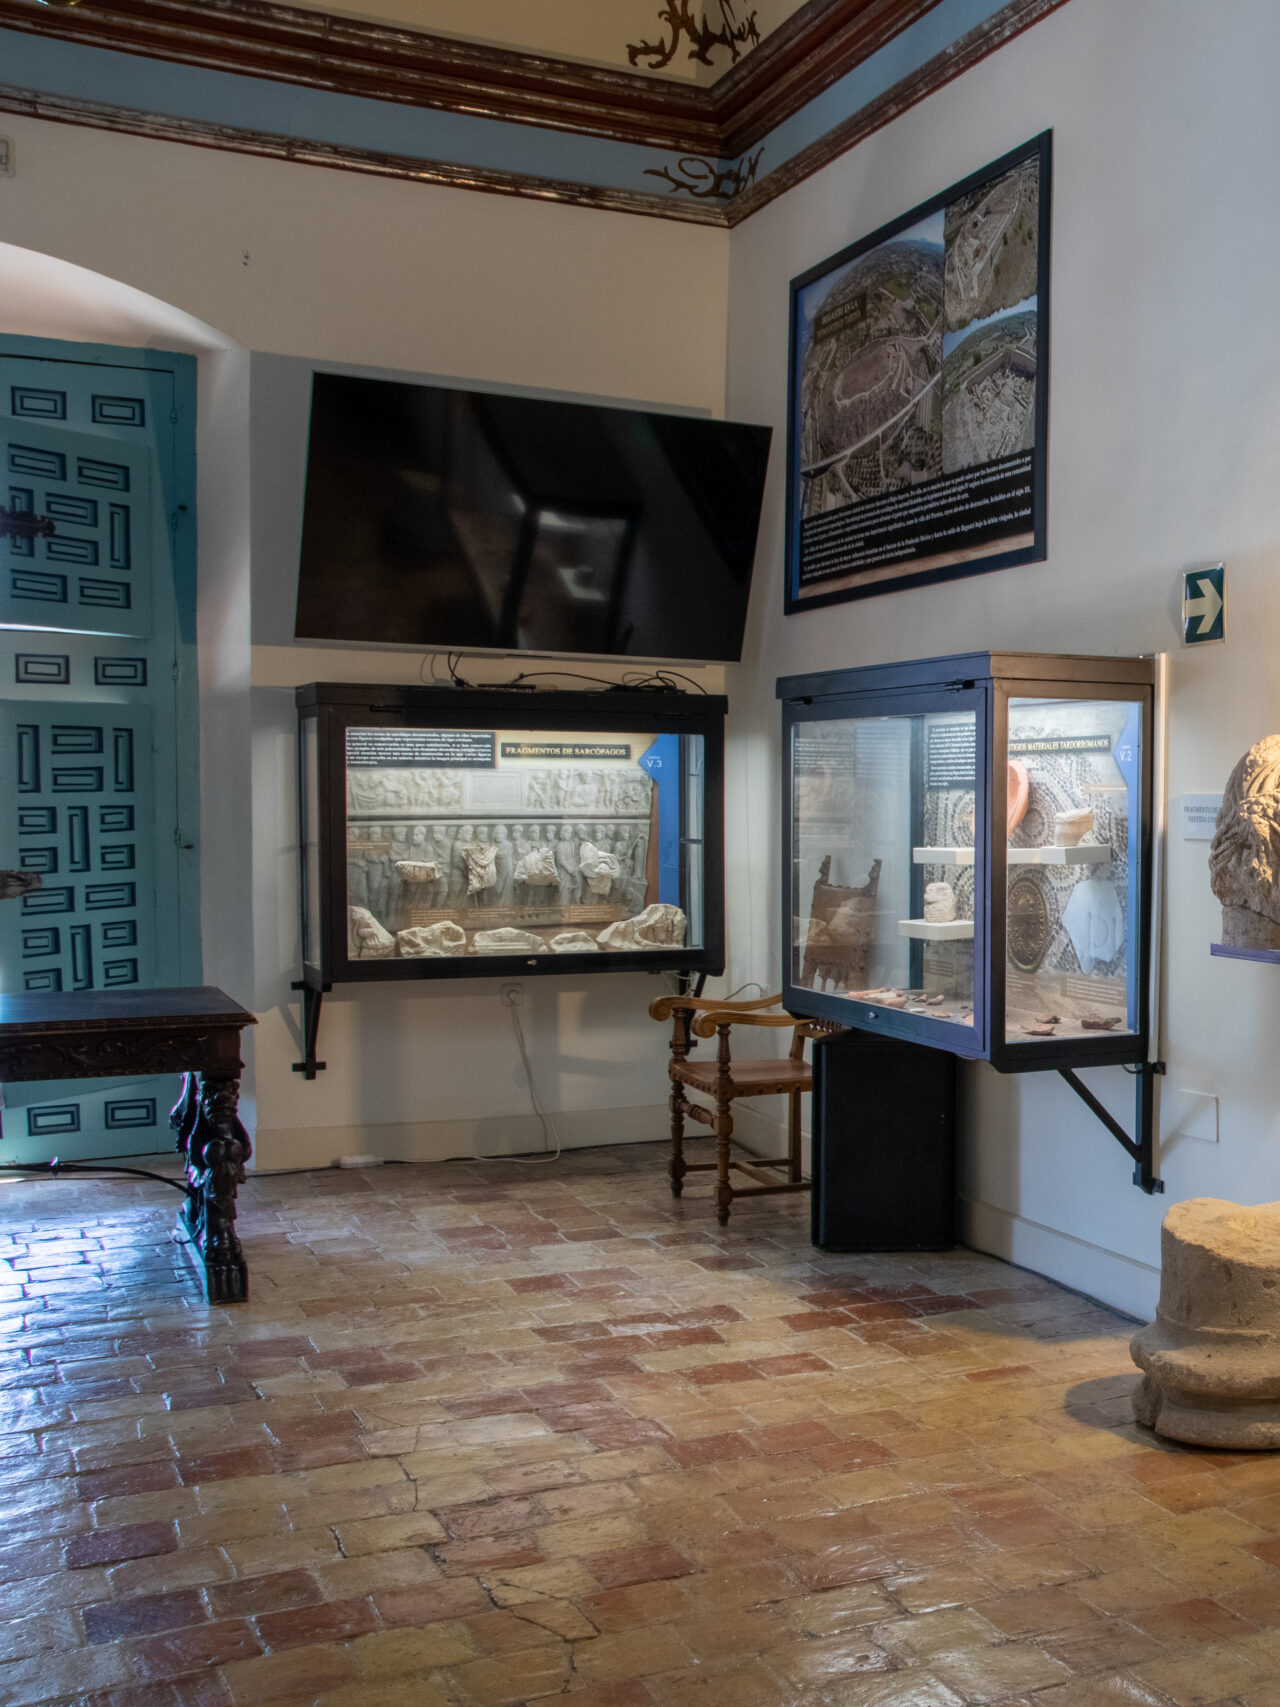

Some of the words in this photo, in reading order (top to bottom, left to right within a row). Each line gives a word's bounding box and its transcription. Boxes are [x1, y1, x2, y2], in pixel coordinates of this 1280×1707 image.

[505, 746, 561, 755] FRAGMENTOS
[562, 747, 574, 755] DE
[574, 746, 626, 756] SARCÓFAGOS
[1120, 750, 1132, 762] V.2
[646, 759, 662, 768] V.3
